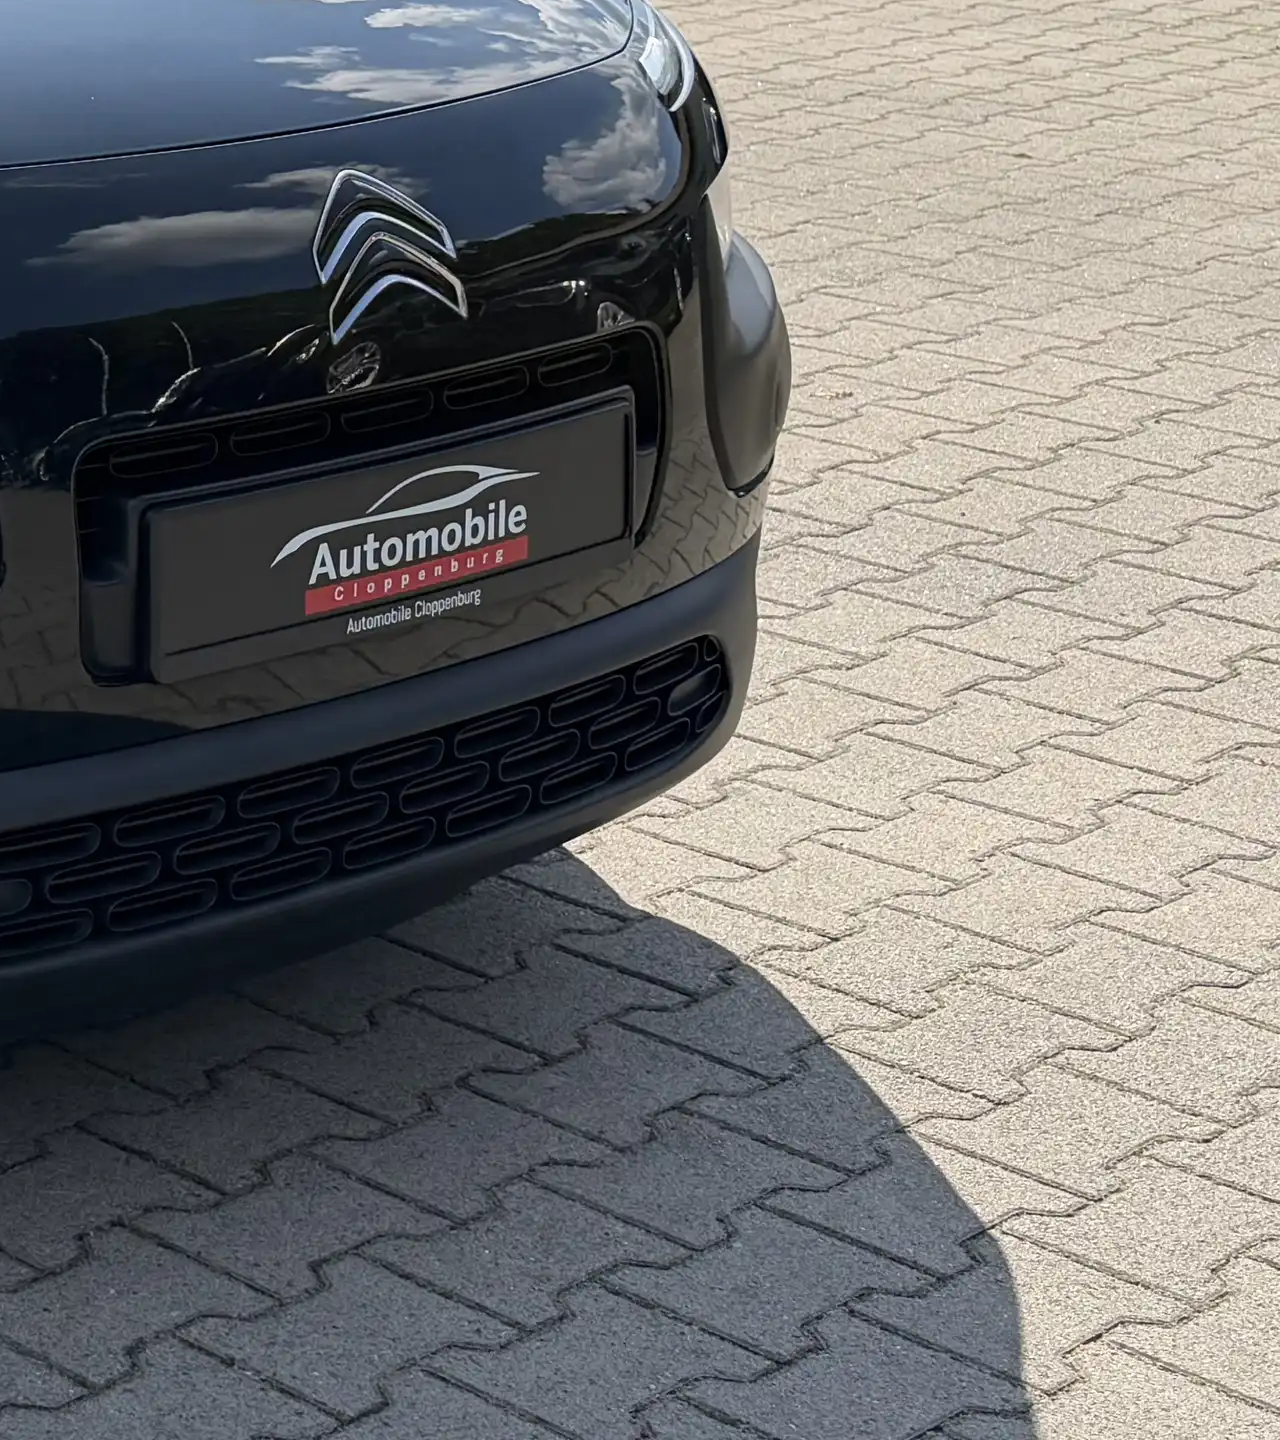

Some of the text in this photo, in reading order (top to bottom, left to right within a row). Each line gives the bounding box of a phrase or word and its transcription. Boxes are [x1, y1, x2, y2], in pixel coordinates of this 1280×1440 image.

[308, 498, 528, 586] Automobile
[334, 549, 504, 601] Cloppenburg
[346, 588, 482, 635] Automobile Cloppenburg
